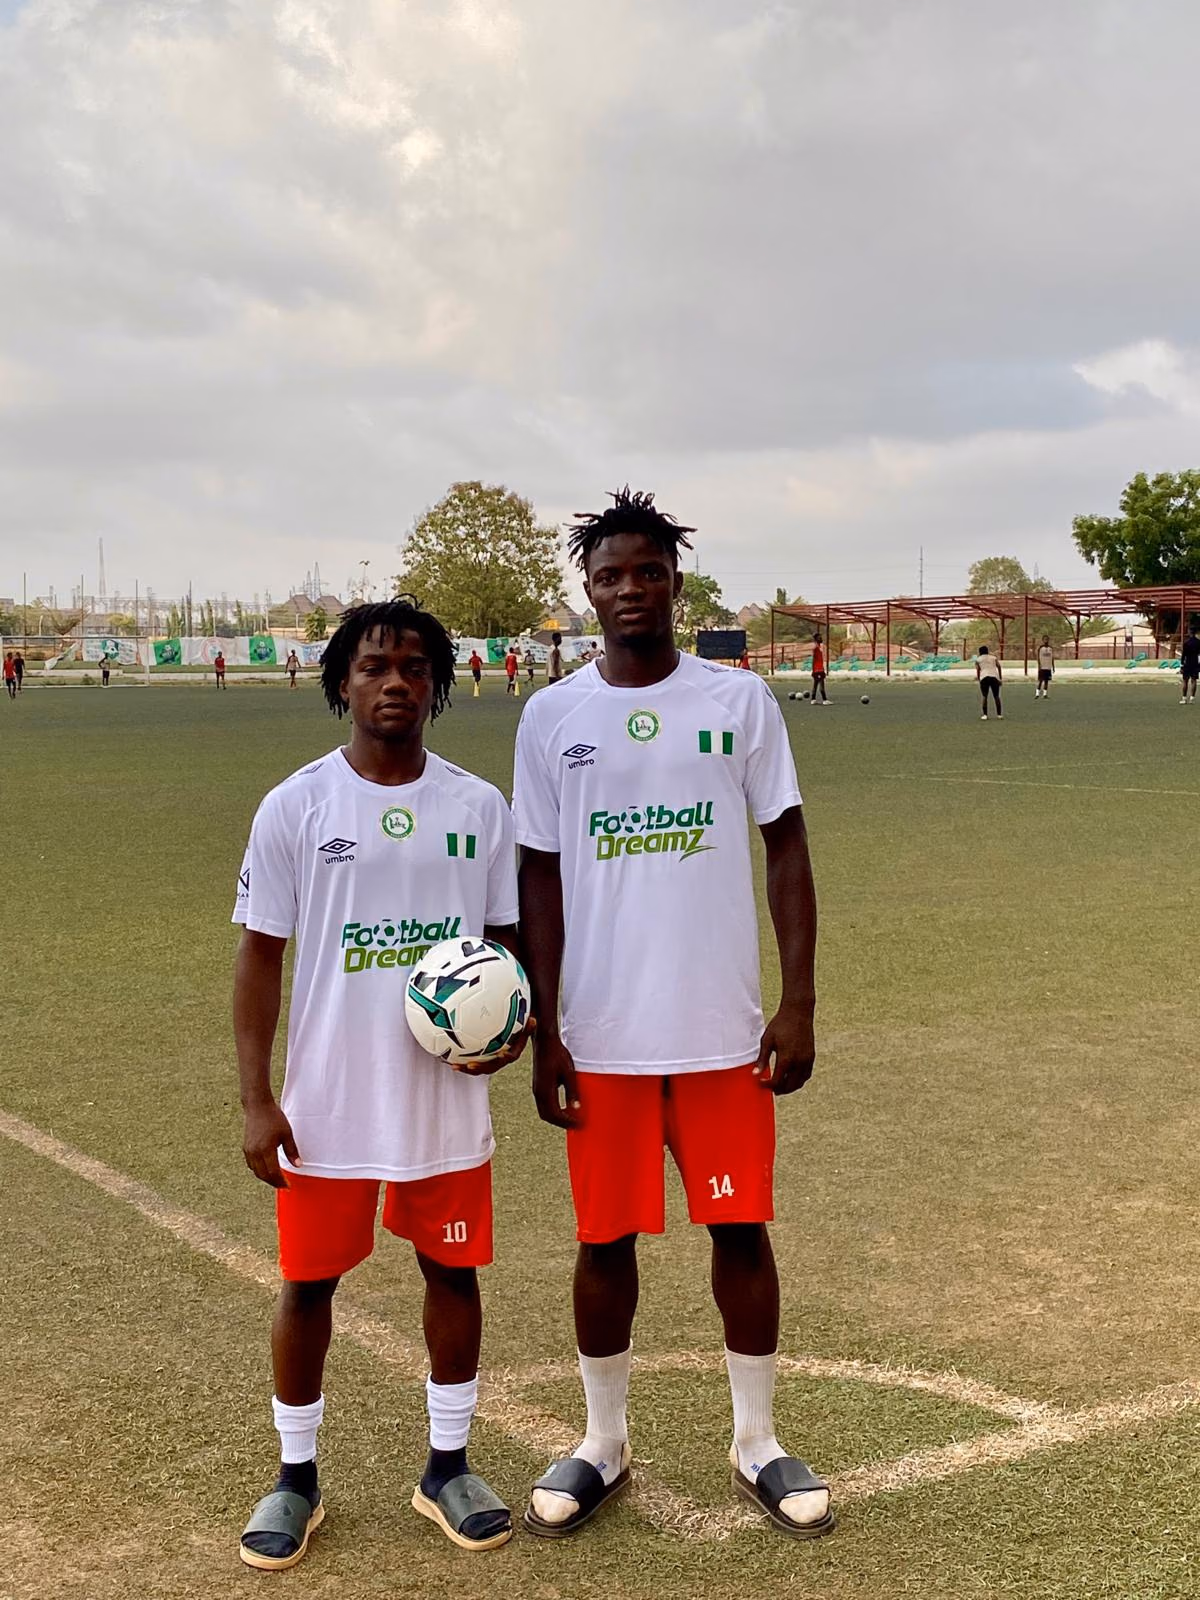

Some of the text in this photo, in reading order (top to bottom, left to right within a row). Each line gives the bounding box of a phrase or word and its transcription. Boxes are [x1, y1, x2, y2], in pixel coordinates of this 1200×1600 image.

[568, 758, 595, 770] umbro
[589, 801, 714, 837] Football
[325, 854, 355, 865] umbro
[341, 917, 461, 948] Football
[344, 944, 433, 974] Dream
[708, 1174, 735, 1200] 14
[442, 1221, 467, 1243] 10
